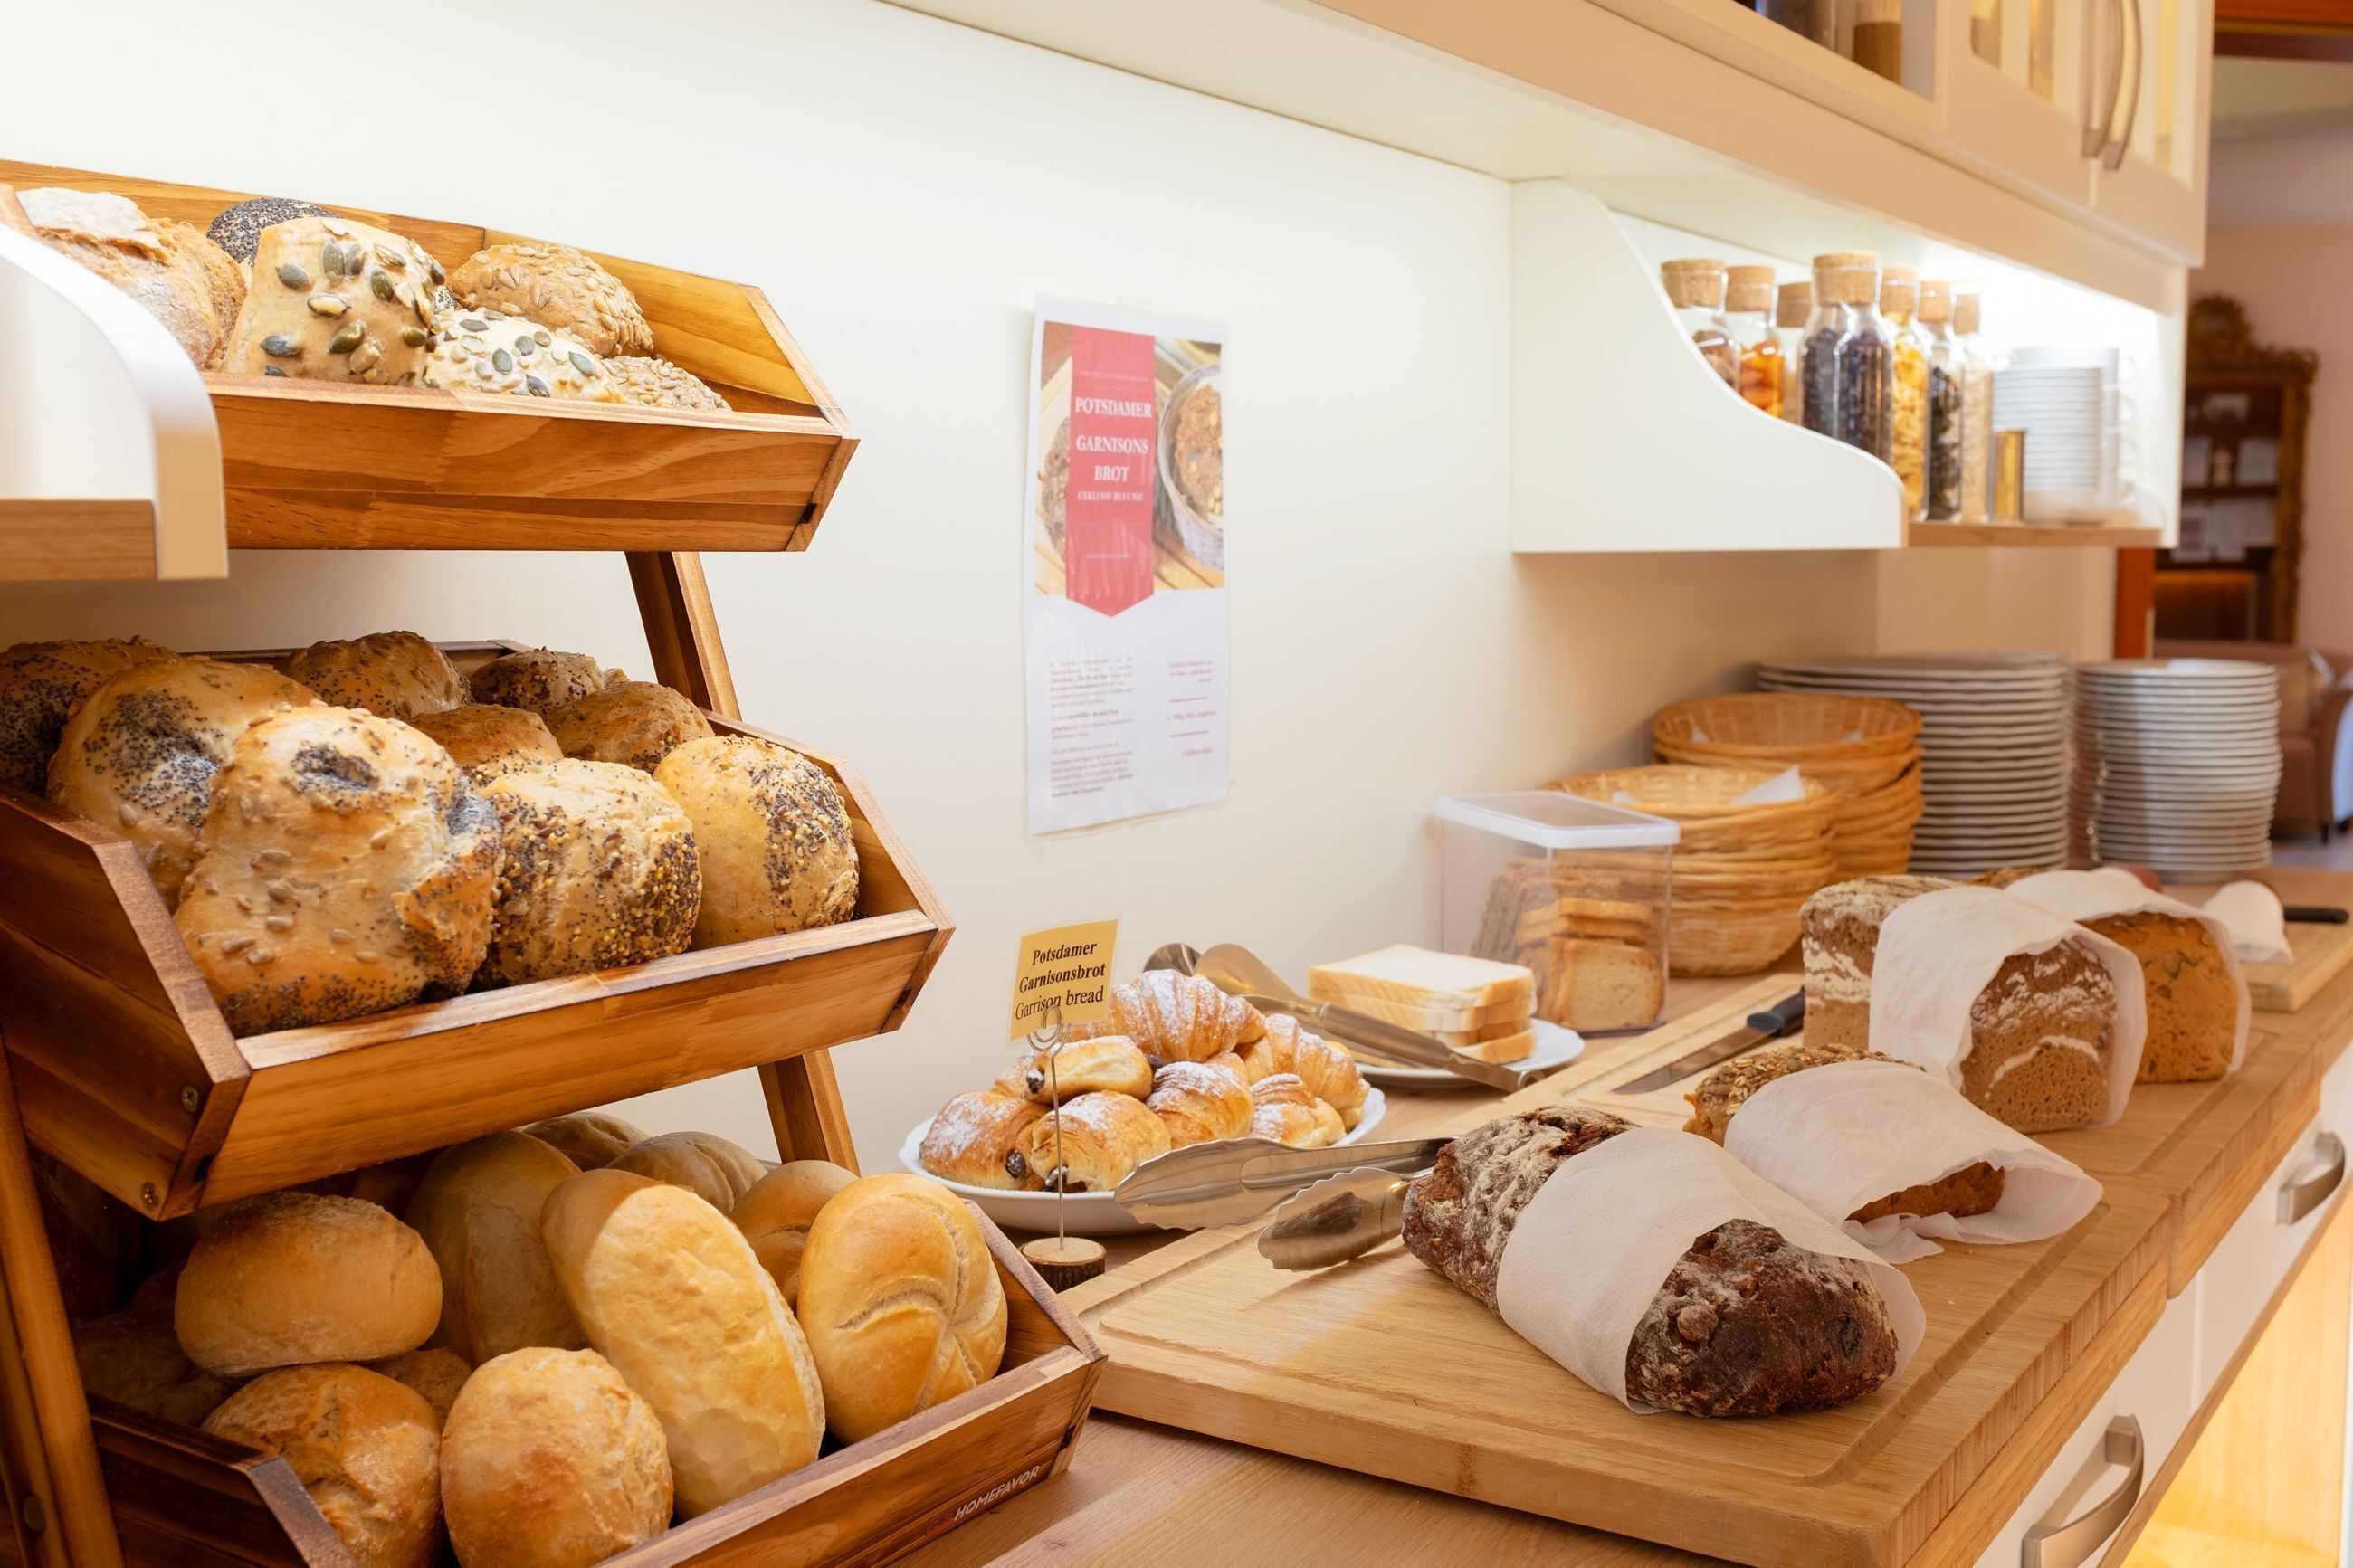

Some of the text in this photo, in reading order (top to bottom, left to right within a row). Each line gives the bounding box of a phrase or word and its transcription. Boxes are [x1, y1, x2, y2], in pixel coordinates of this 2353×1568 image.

[1074, 396, 1152, 418] POTSDAMER
[1076, 434, 1149, 455] GARNISONS
[1093, 465, 1129, 482] BROT
[1031, 942, 1097, 966] Potsdamer
[1019, 963, 1106, 993] Garnisonsbrot
[1015, 985, 1104, 1021] Garrison bread
[954, 1465, 1040, 1522] HOMEFAVOR
